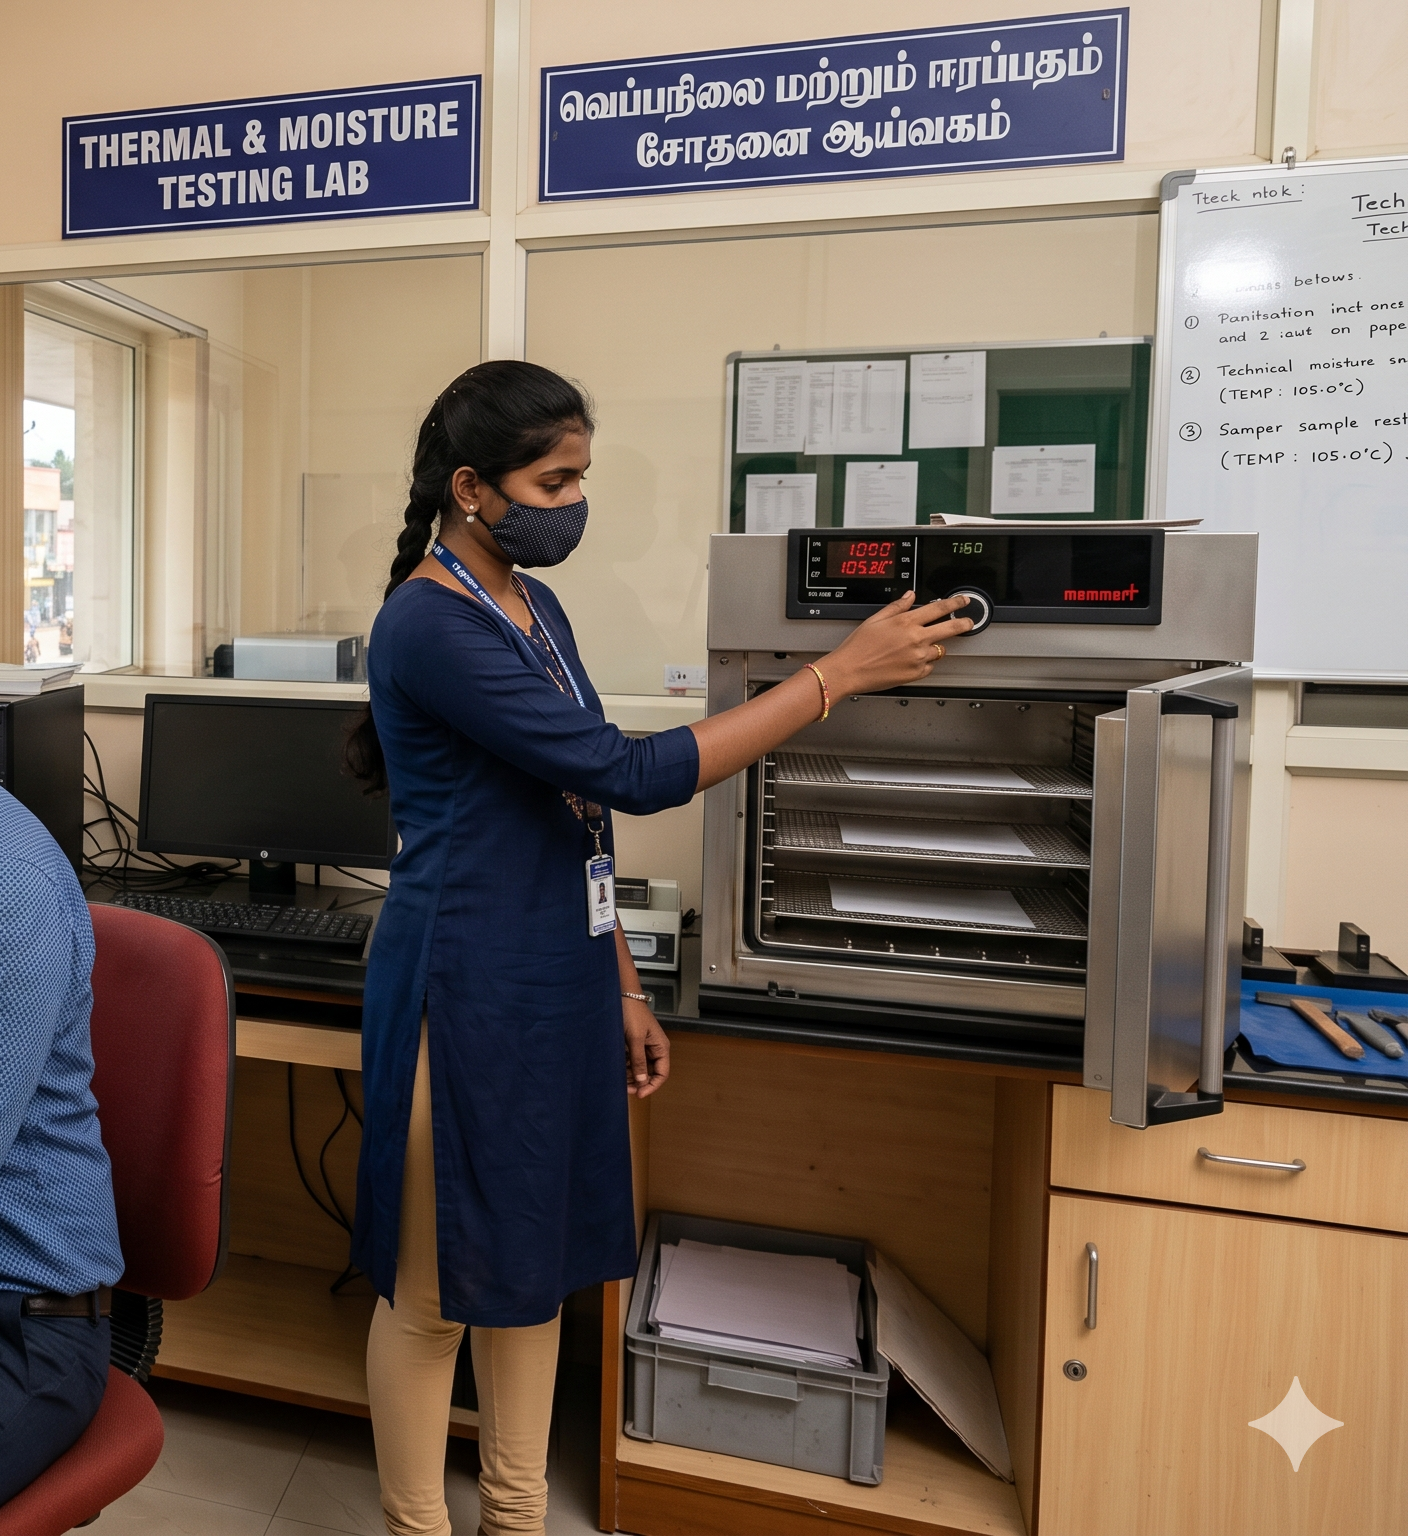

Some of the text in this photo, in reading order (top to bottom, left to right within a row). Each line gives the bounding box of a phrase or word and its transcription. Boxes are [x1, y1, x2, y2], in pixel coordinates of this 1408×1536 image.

[559, 31, 1103, 123] வெப்பநிலை மற்றும் ஈரப்பதம்
[79, 100, 459, 170] THERMAL & MOISTURE
[636, 98, 1011, 172] சோதனை ஆய்வகம்
[158, 160, 369, 210] TESTING LAB
[1351, 192, 1405, 212] Tech
[1218, 306, 1314, 324] Panitsation
[1219, 331, 1246, 343] and
[1259, 331, 1269, 341] 2
[1331, 326, 1350, 335] on
[1217, 359, 1293, 376] Technical
[1310, 357, 1375, 370] moisture
[1219, 423, 1283, 440] Samper
[1299, 416, 1359, 435] sample
[1064, 583, 1139, 601] memmert
